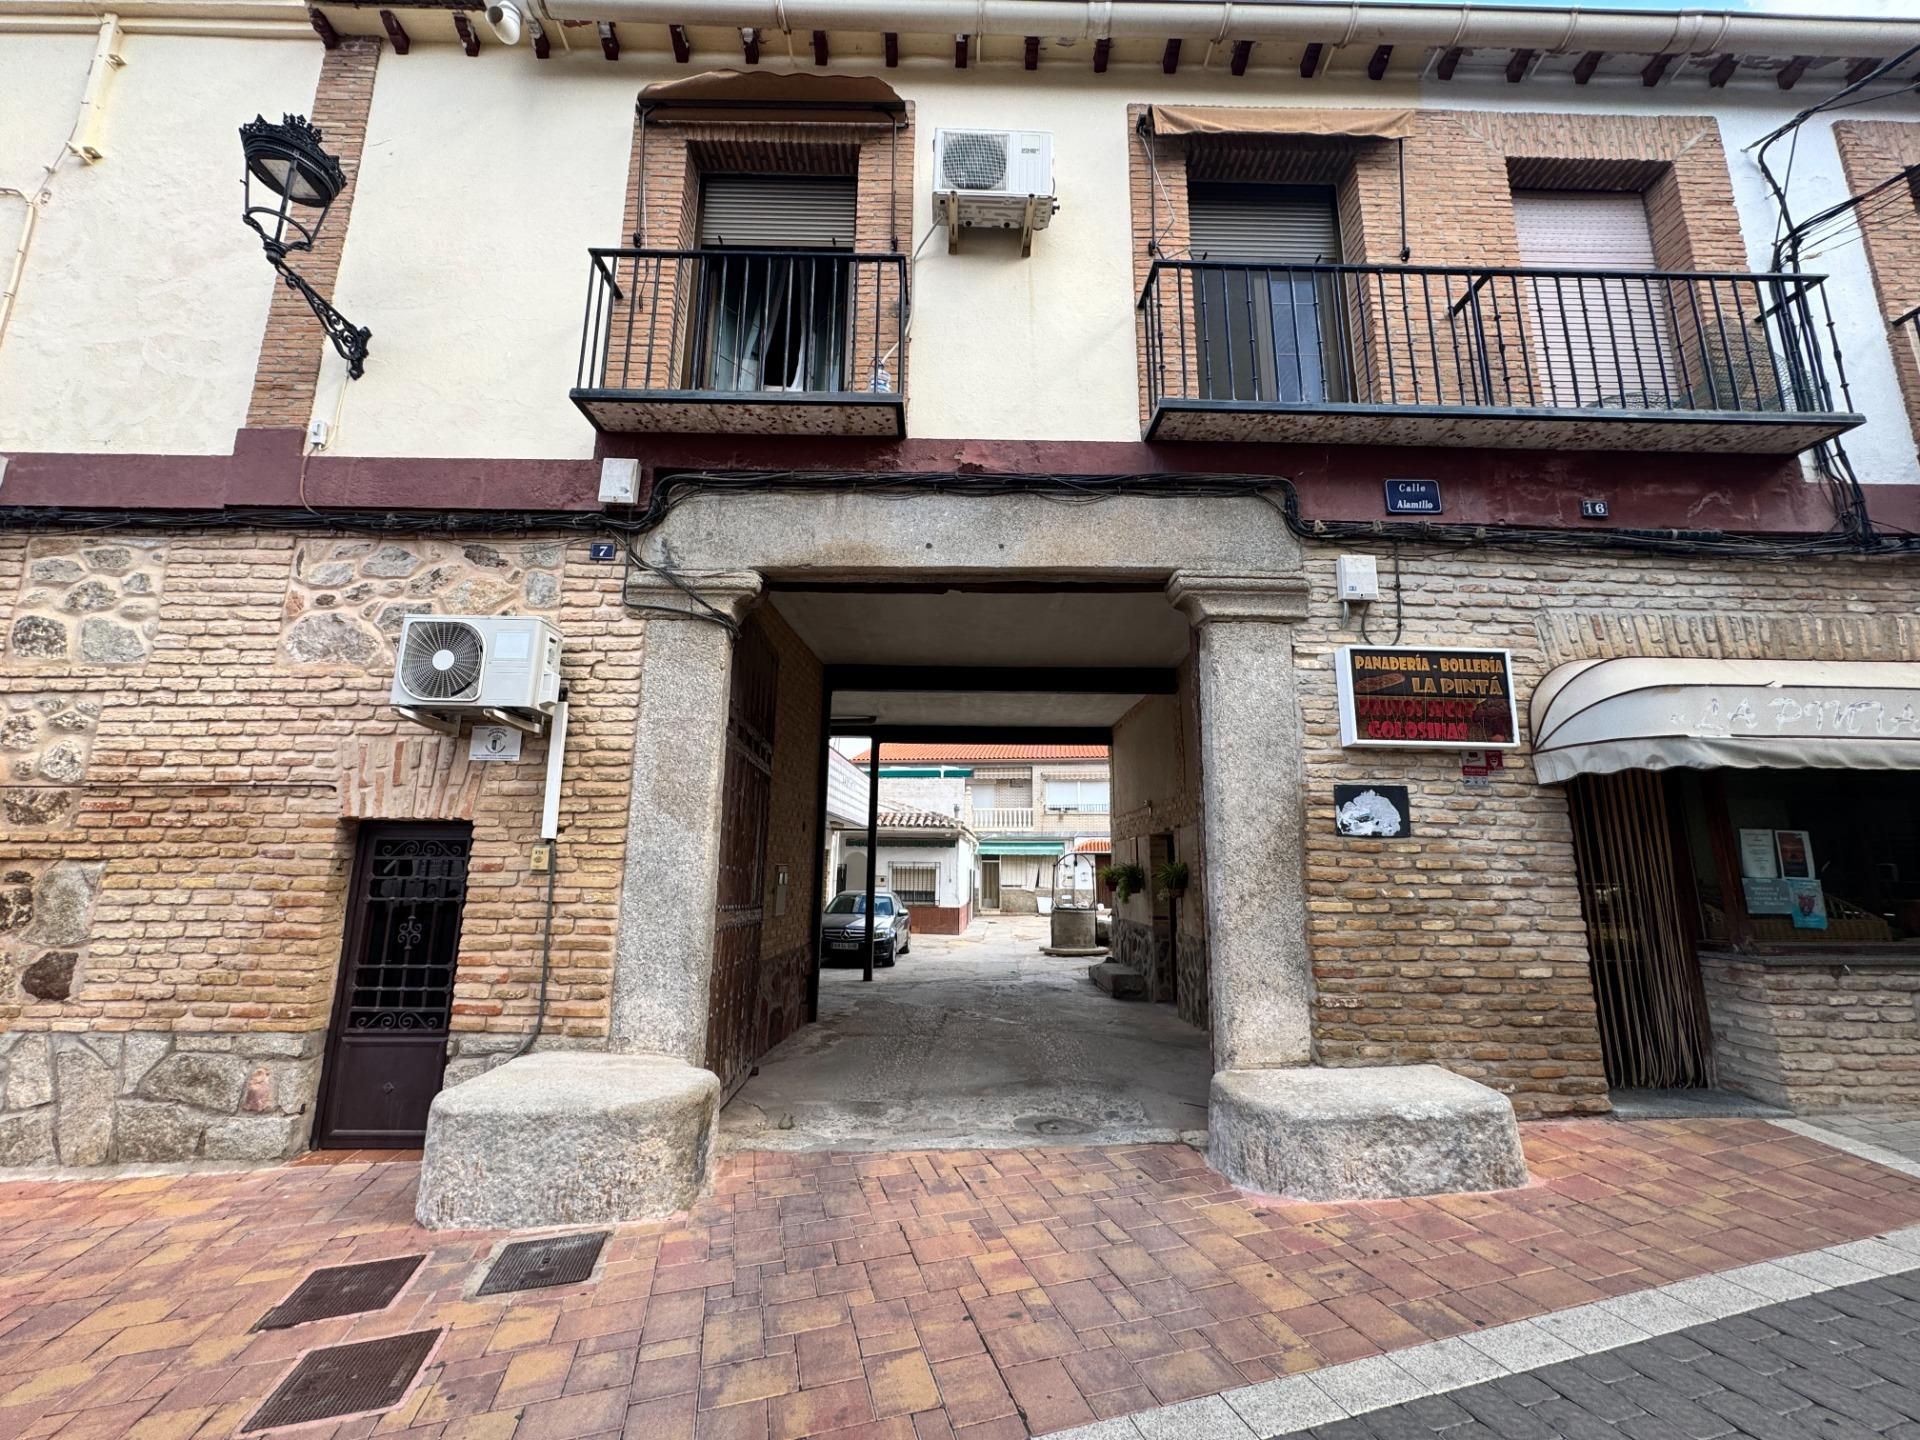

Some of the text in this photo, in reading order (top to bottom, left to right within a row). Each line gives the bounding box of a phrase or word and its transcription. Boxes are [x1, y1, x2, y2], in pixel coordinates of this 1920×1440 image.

[1398, 483, 1426, 493] Calle
[1396, 499, 1434, 509] Alamillo
[1585, 503, 1605, 514] 16
[599, 545, 608, 557] 7
[1354, 654, 1430, 671] PANADERÍA
[1440, 656, 1504, 673] BOLLERÍA
[1412, 676, 1503, 695] LA PINTÁ
[1367, 720, 1470, 740] GOLOSINAS
